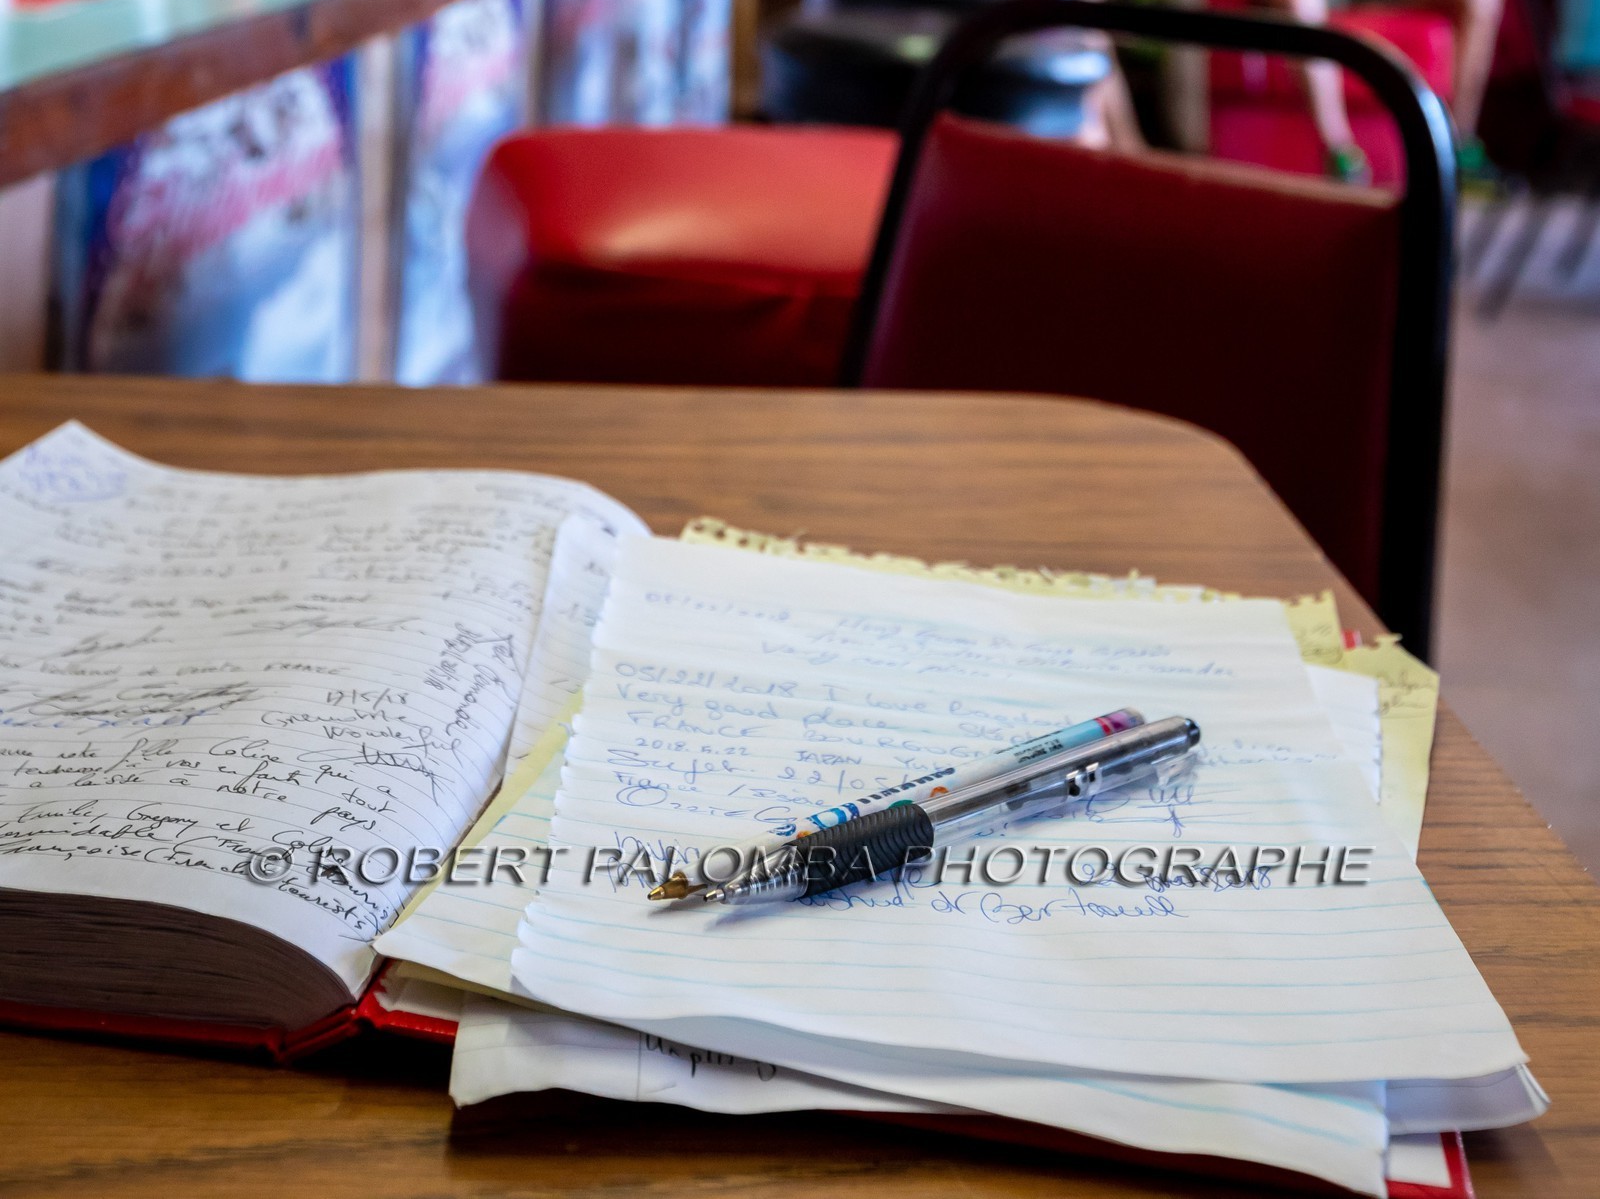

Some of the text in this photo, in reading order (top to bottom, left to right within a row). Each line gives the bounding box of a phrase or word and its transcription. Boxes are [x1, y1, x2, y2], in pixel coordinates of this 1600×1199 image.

[617, 683, 688, 717] Very
[704, 700, 779, 721] good
[627, 711, 772, 738] FRANCE
[208, 736, 285, 764] Coline
[216, 781, 288, 802] notre
[342, 787, 398, 814] tout
